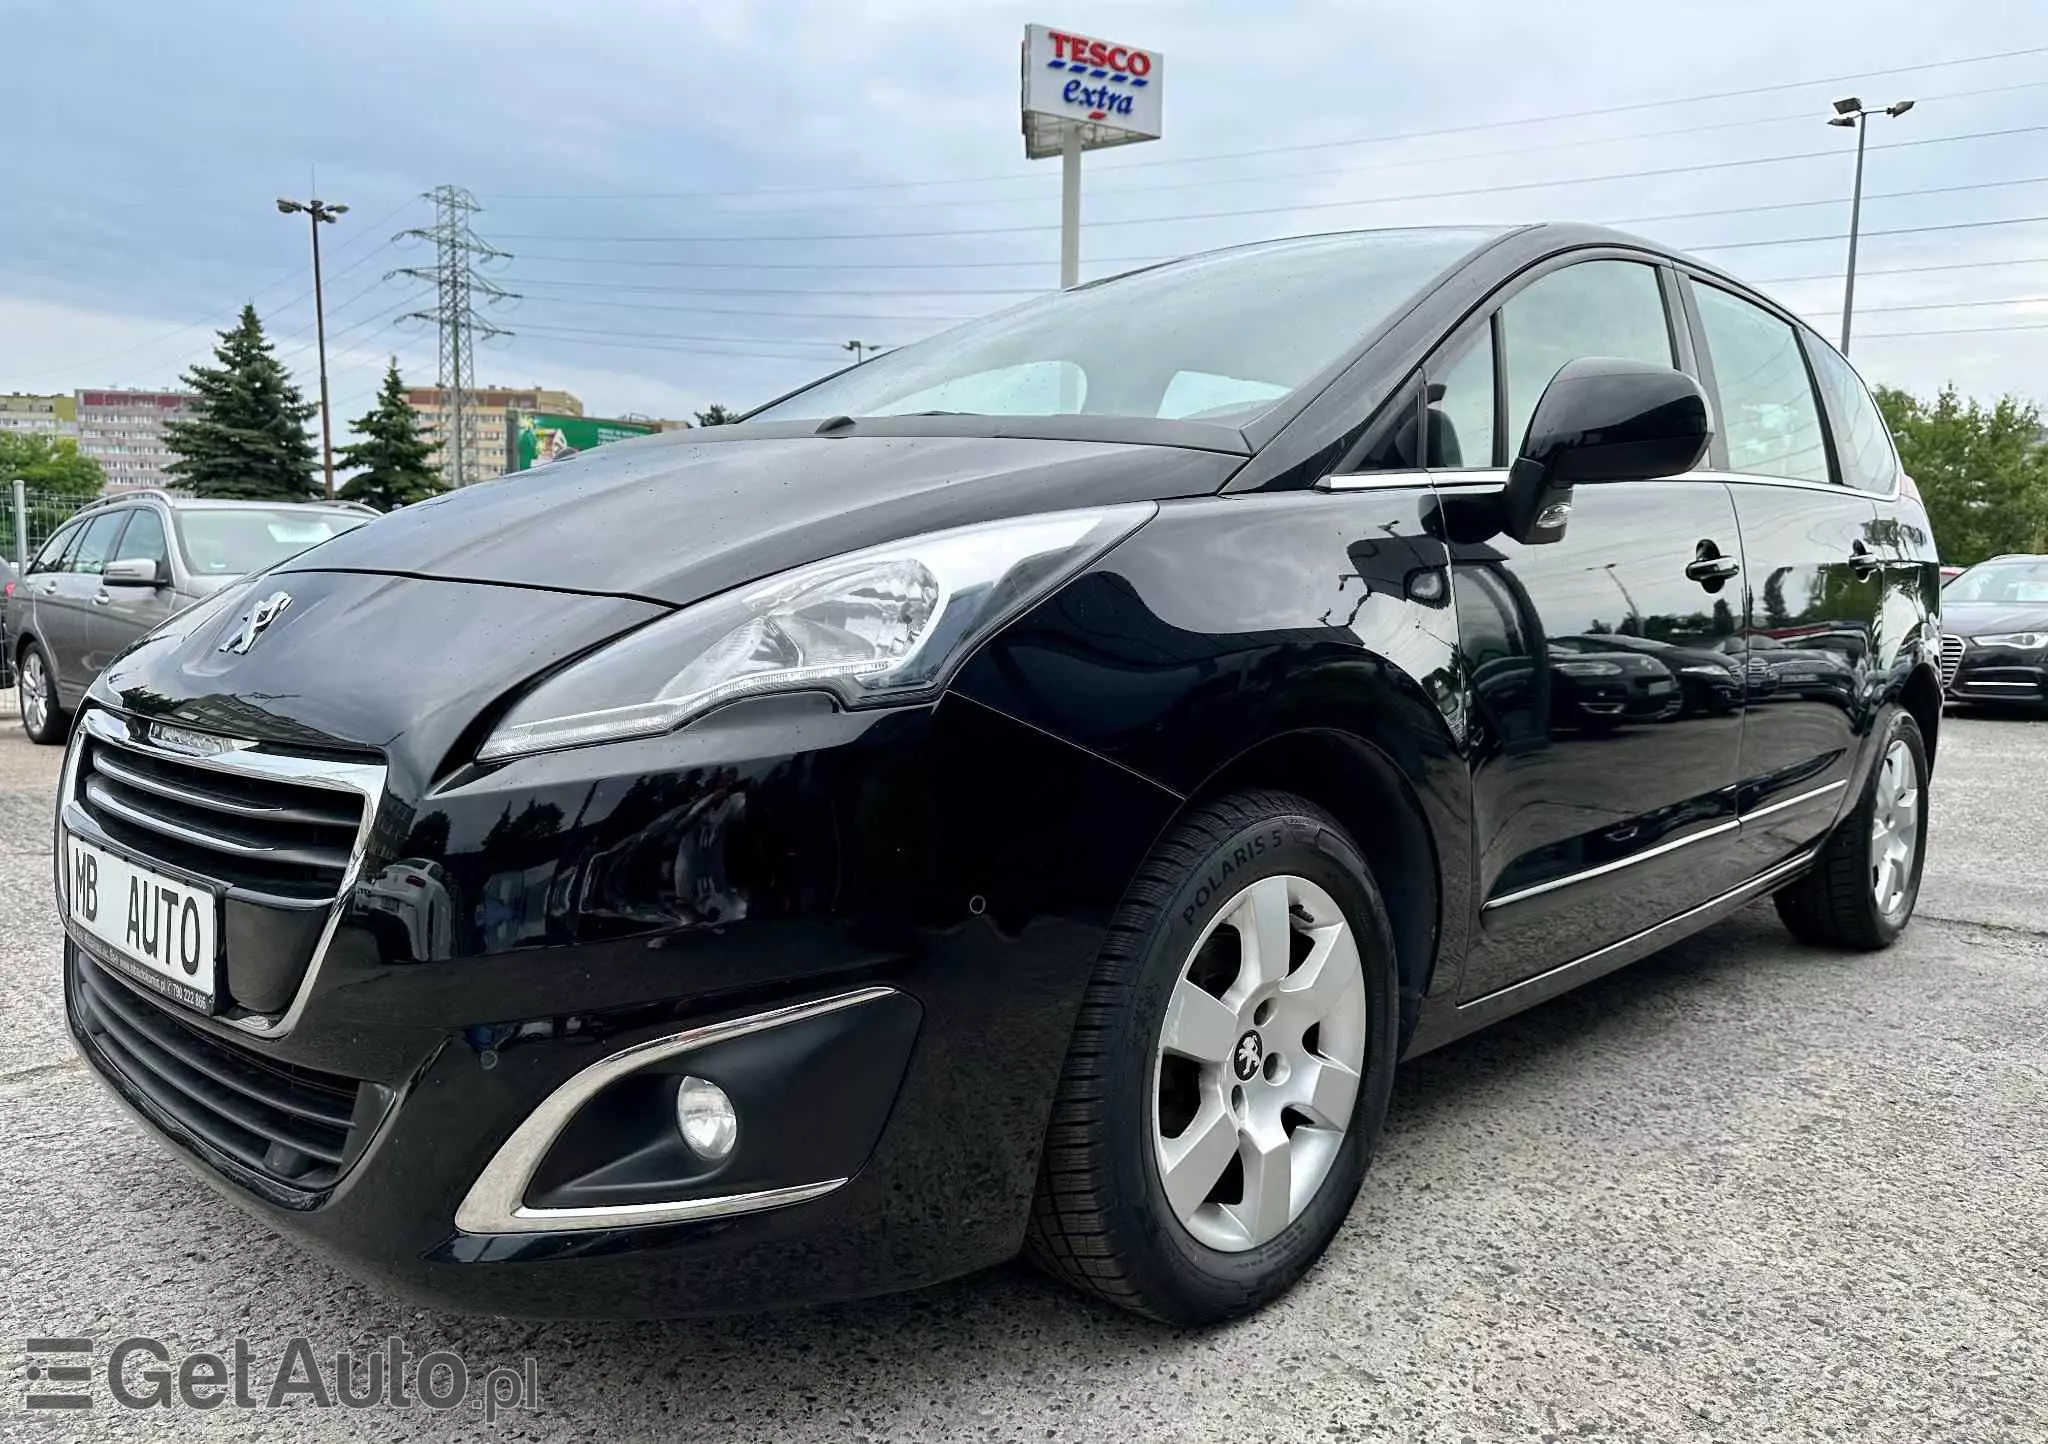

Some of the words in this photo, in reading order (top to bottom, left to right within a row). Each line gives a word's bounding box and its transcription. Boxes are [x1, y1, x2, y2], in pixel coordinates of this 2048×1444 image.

[1048, 32, 1151, 76] TESCO
[1063, 79, 1134, 115] extra
[75, 847, 97, 921] MB
[127, 875, 200, 975] AUTO
[1182, 836, 1264, 926] POLARIS
